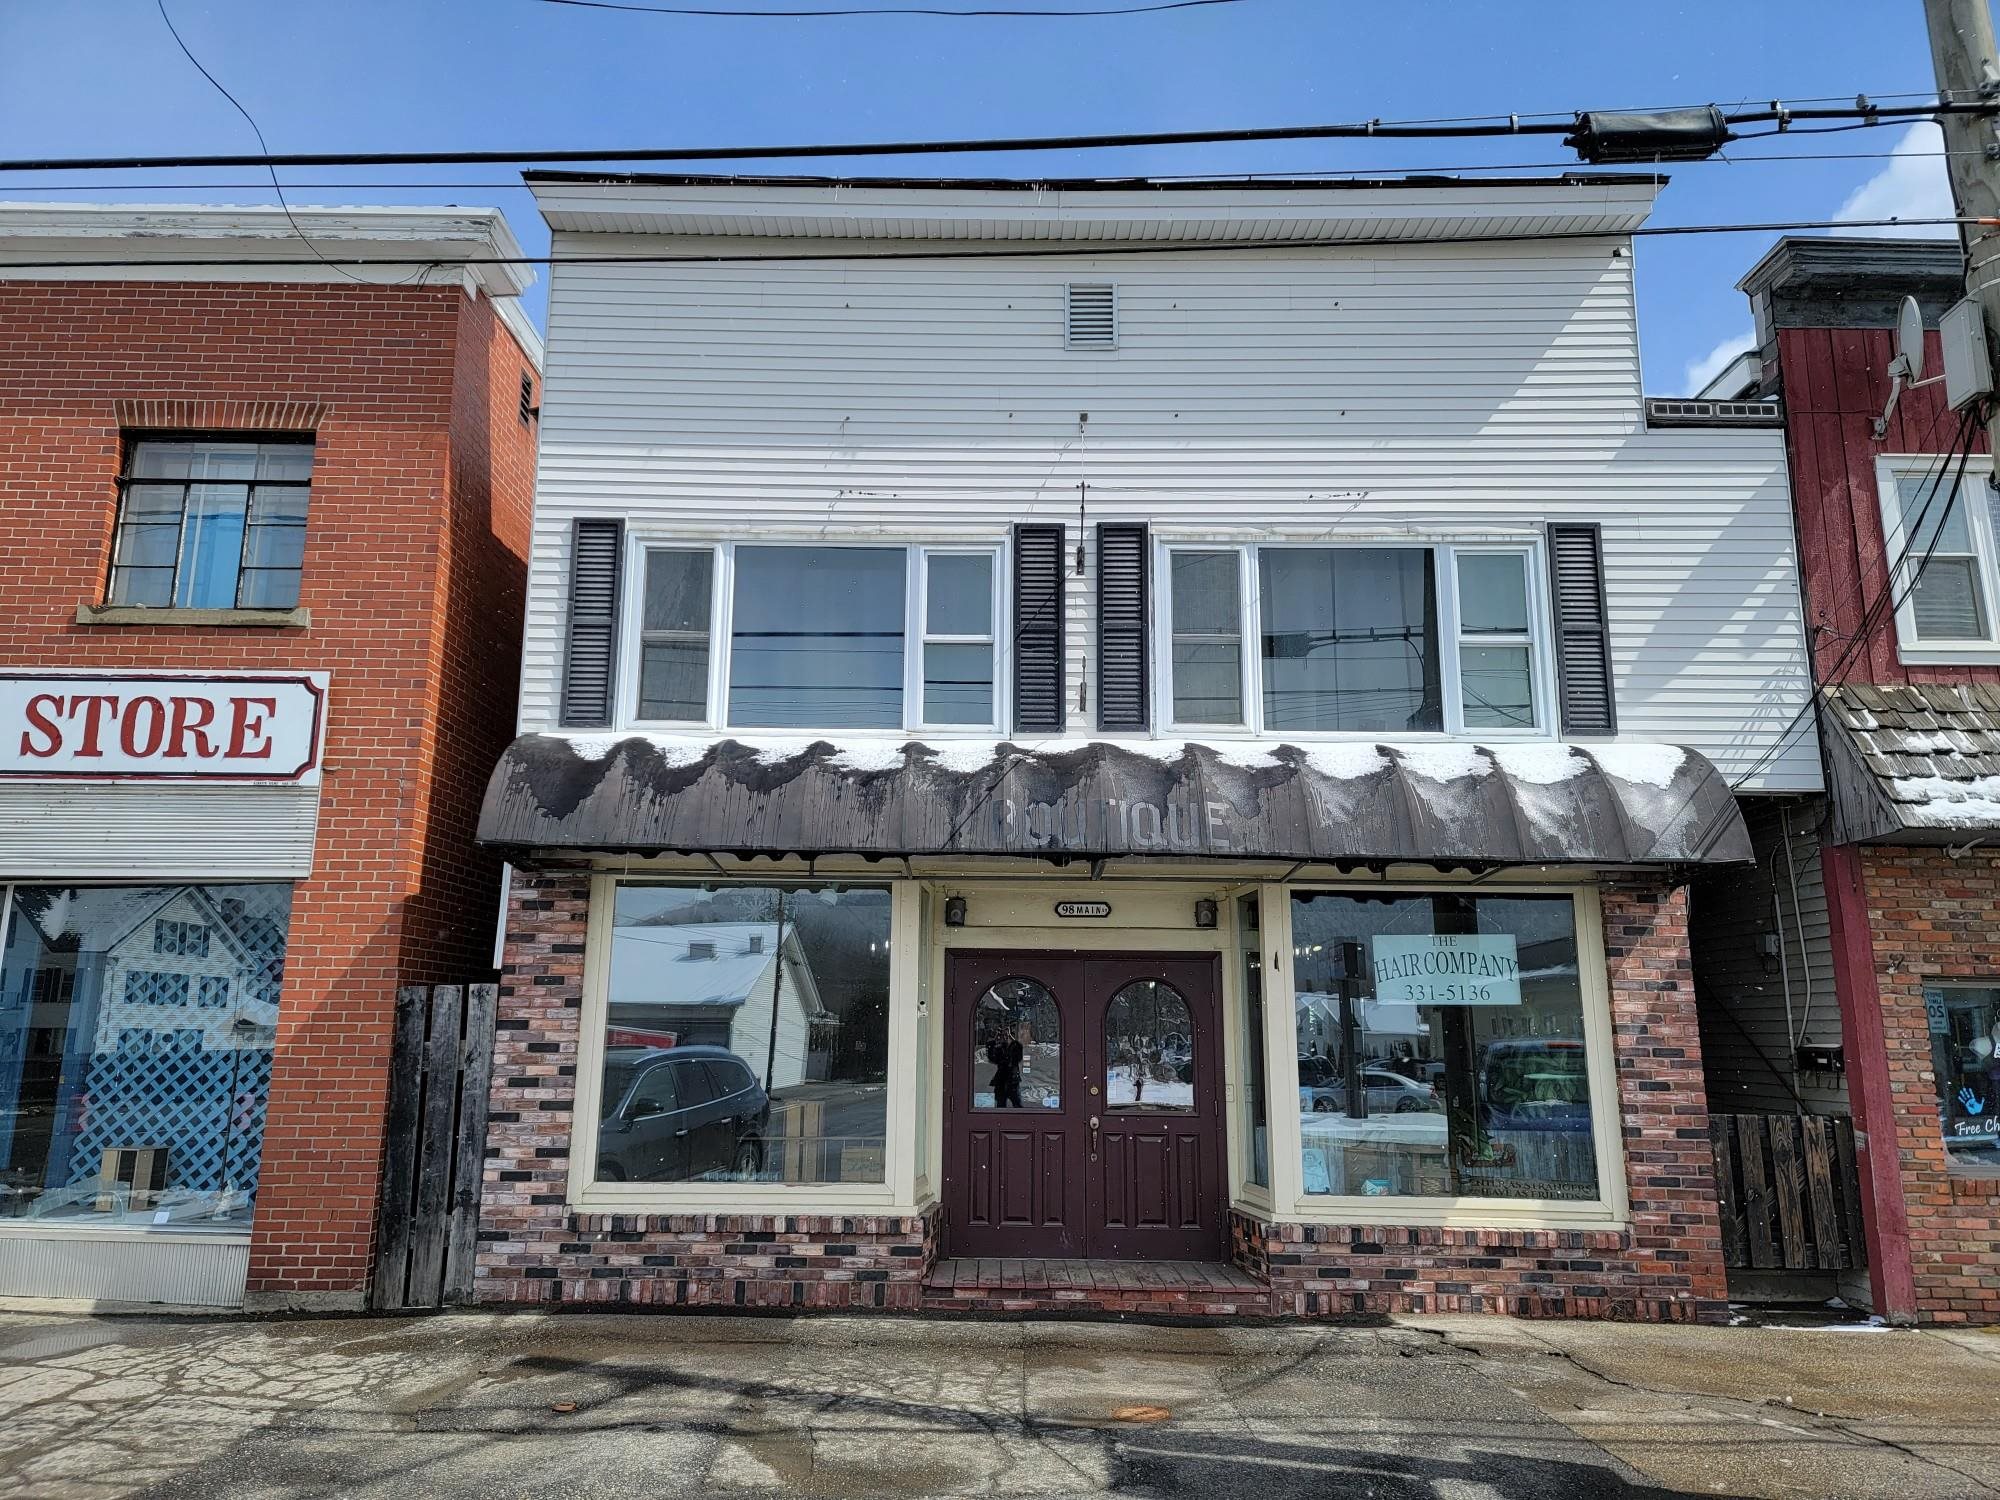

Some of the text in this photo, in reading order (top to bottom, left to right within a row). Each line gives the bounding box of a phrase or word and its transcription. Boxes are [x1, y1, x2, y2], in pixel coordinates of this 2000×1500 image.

[19, 693, 277, 758] STORE
[991, 798, 1231, 847] BOUIQUE
[1062, 904, 1075, 915] 98
[1076, 905, 1101, 915] MAIN
[1432, 935, 1458, 947] THE
[1404, 984, 1491, 1001] 331-5136
[1954, 1121, 1981, 1136] Free
